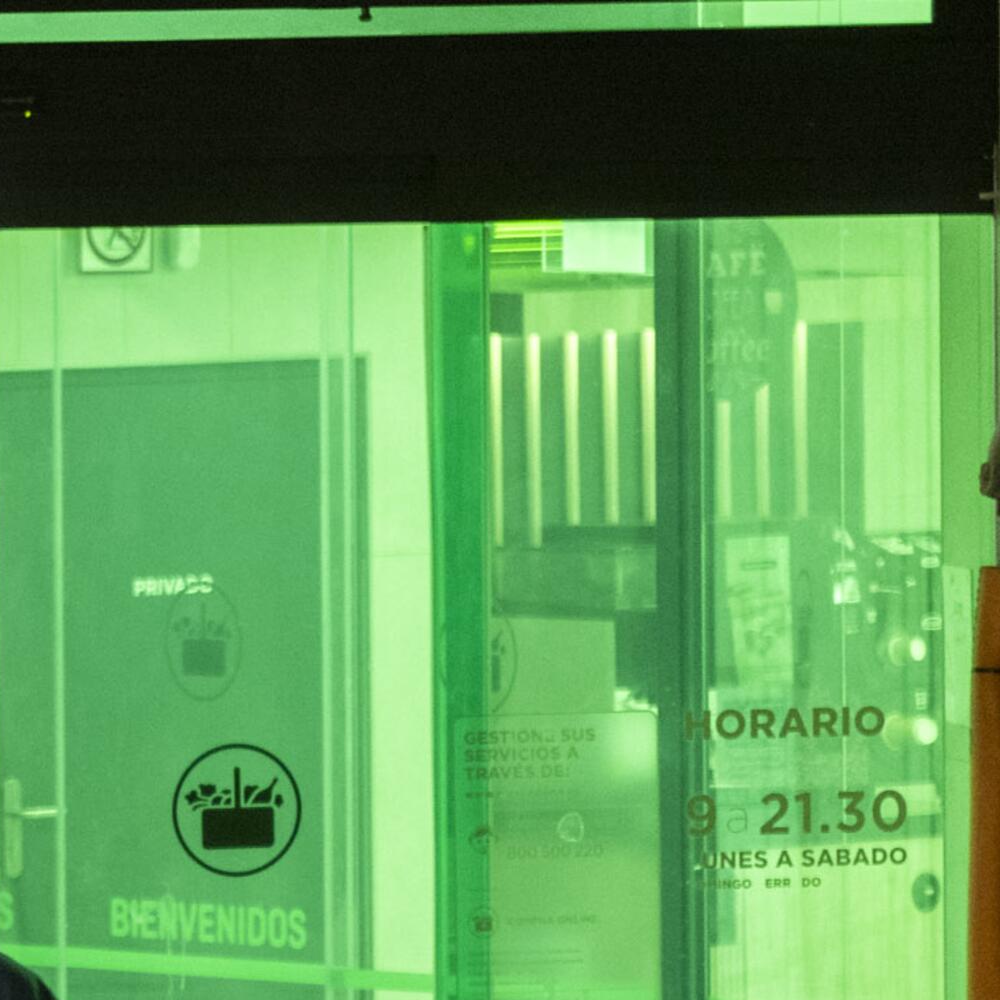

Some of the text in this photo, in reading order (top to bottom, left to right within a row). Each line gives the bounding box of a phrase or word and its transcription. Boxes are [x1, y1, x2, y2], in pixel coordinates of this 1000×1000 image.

[561, 728, 596, 742] SUS
[685, 705, 886, 740] HORARIO
[465, 746, 579, 762] SERVICIOS A
[686, 789, 908, 837] 9 a 21.30
[702, 847, 908, 869] UNES A SABADO
[110, 898, 307, 950] BIENVENIDOS
